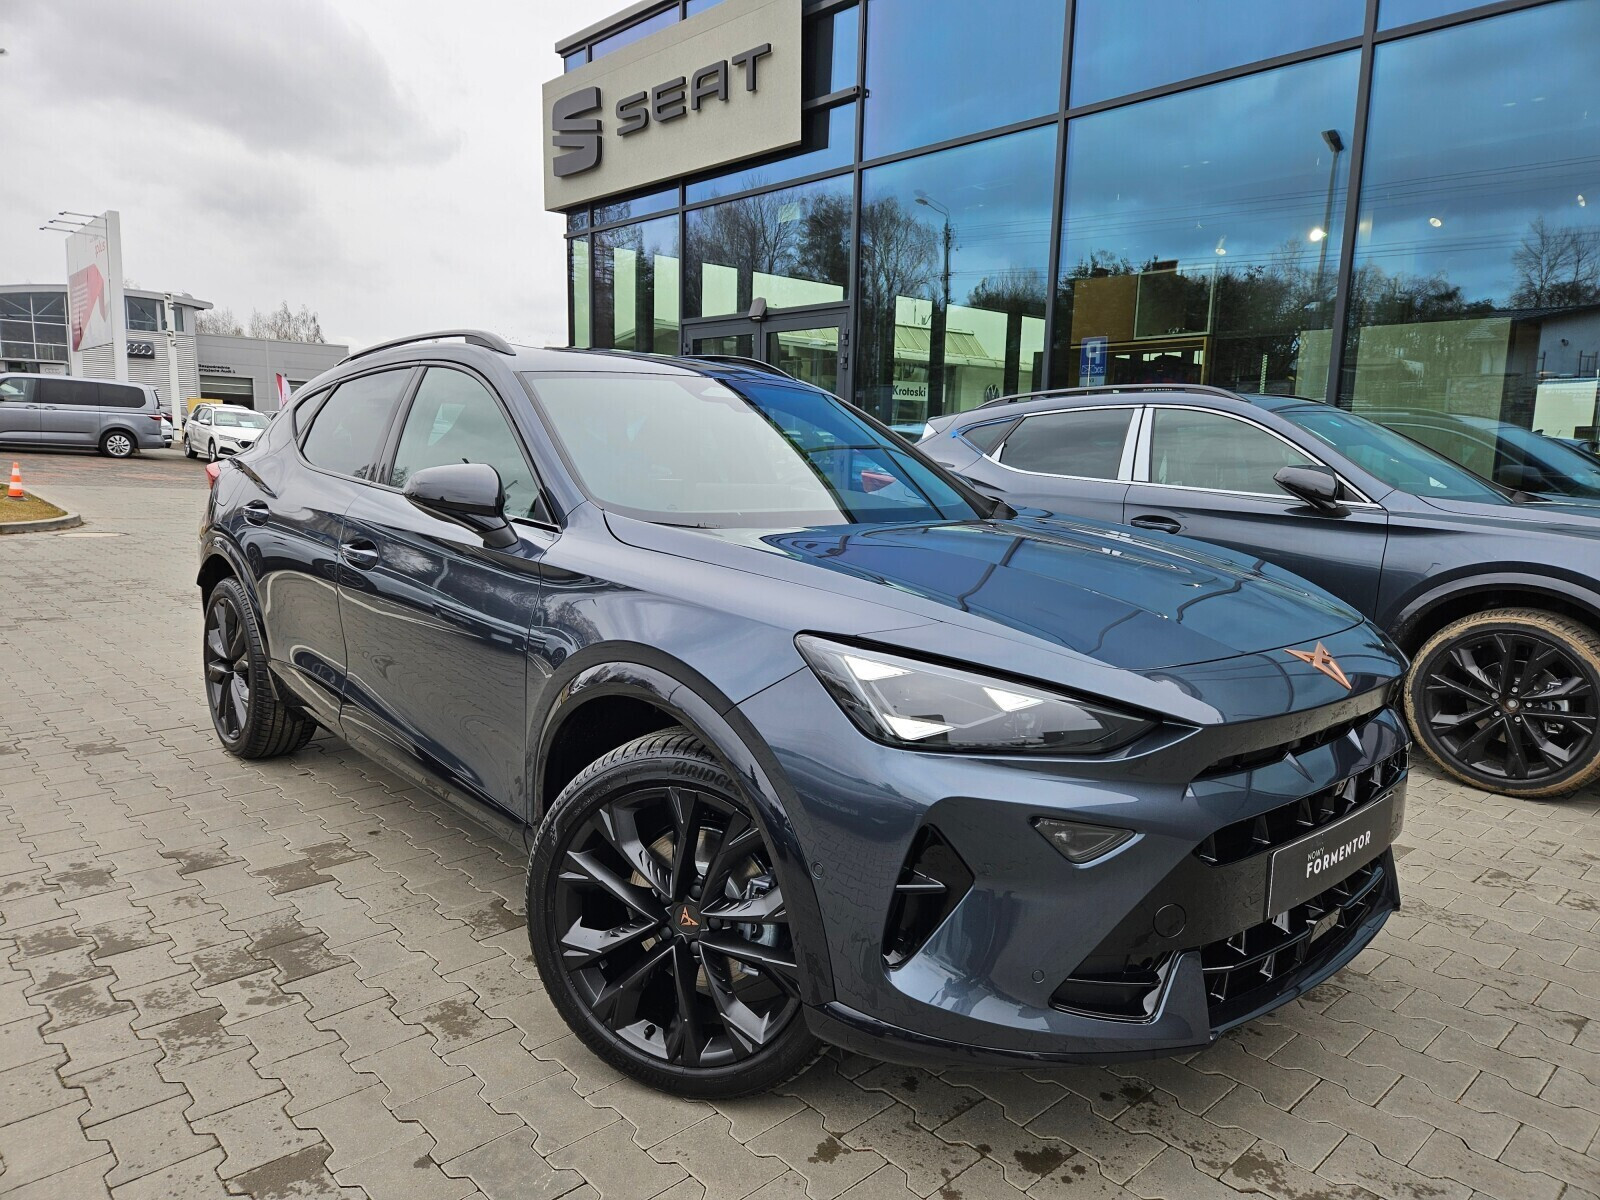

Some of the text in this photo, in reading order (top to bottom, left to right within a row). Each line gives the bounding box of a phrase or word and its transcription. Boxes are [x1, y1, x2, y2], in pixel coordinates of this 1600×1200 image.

[616, 43, 772, 136] SEAT
[893, 385, 926, 396] Krotoski
[1306, 830, 1371, 879] FORMENTOR
[1307, 847, 1325, 861] NOWY
